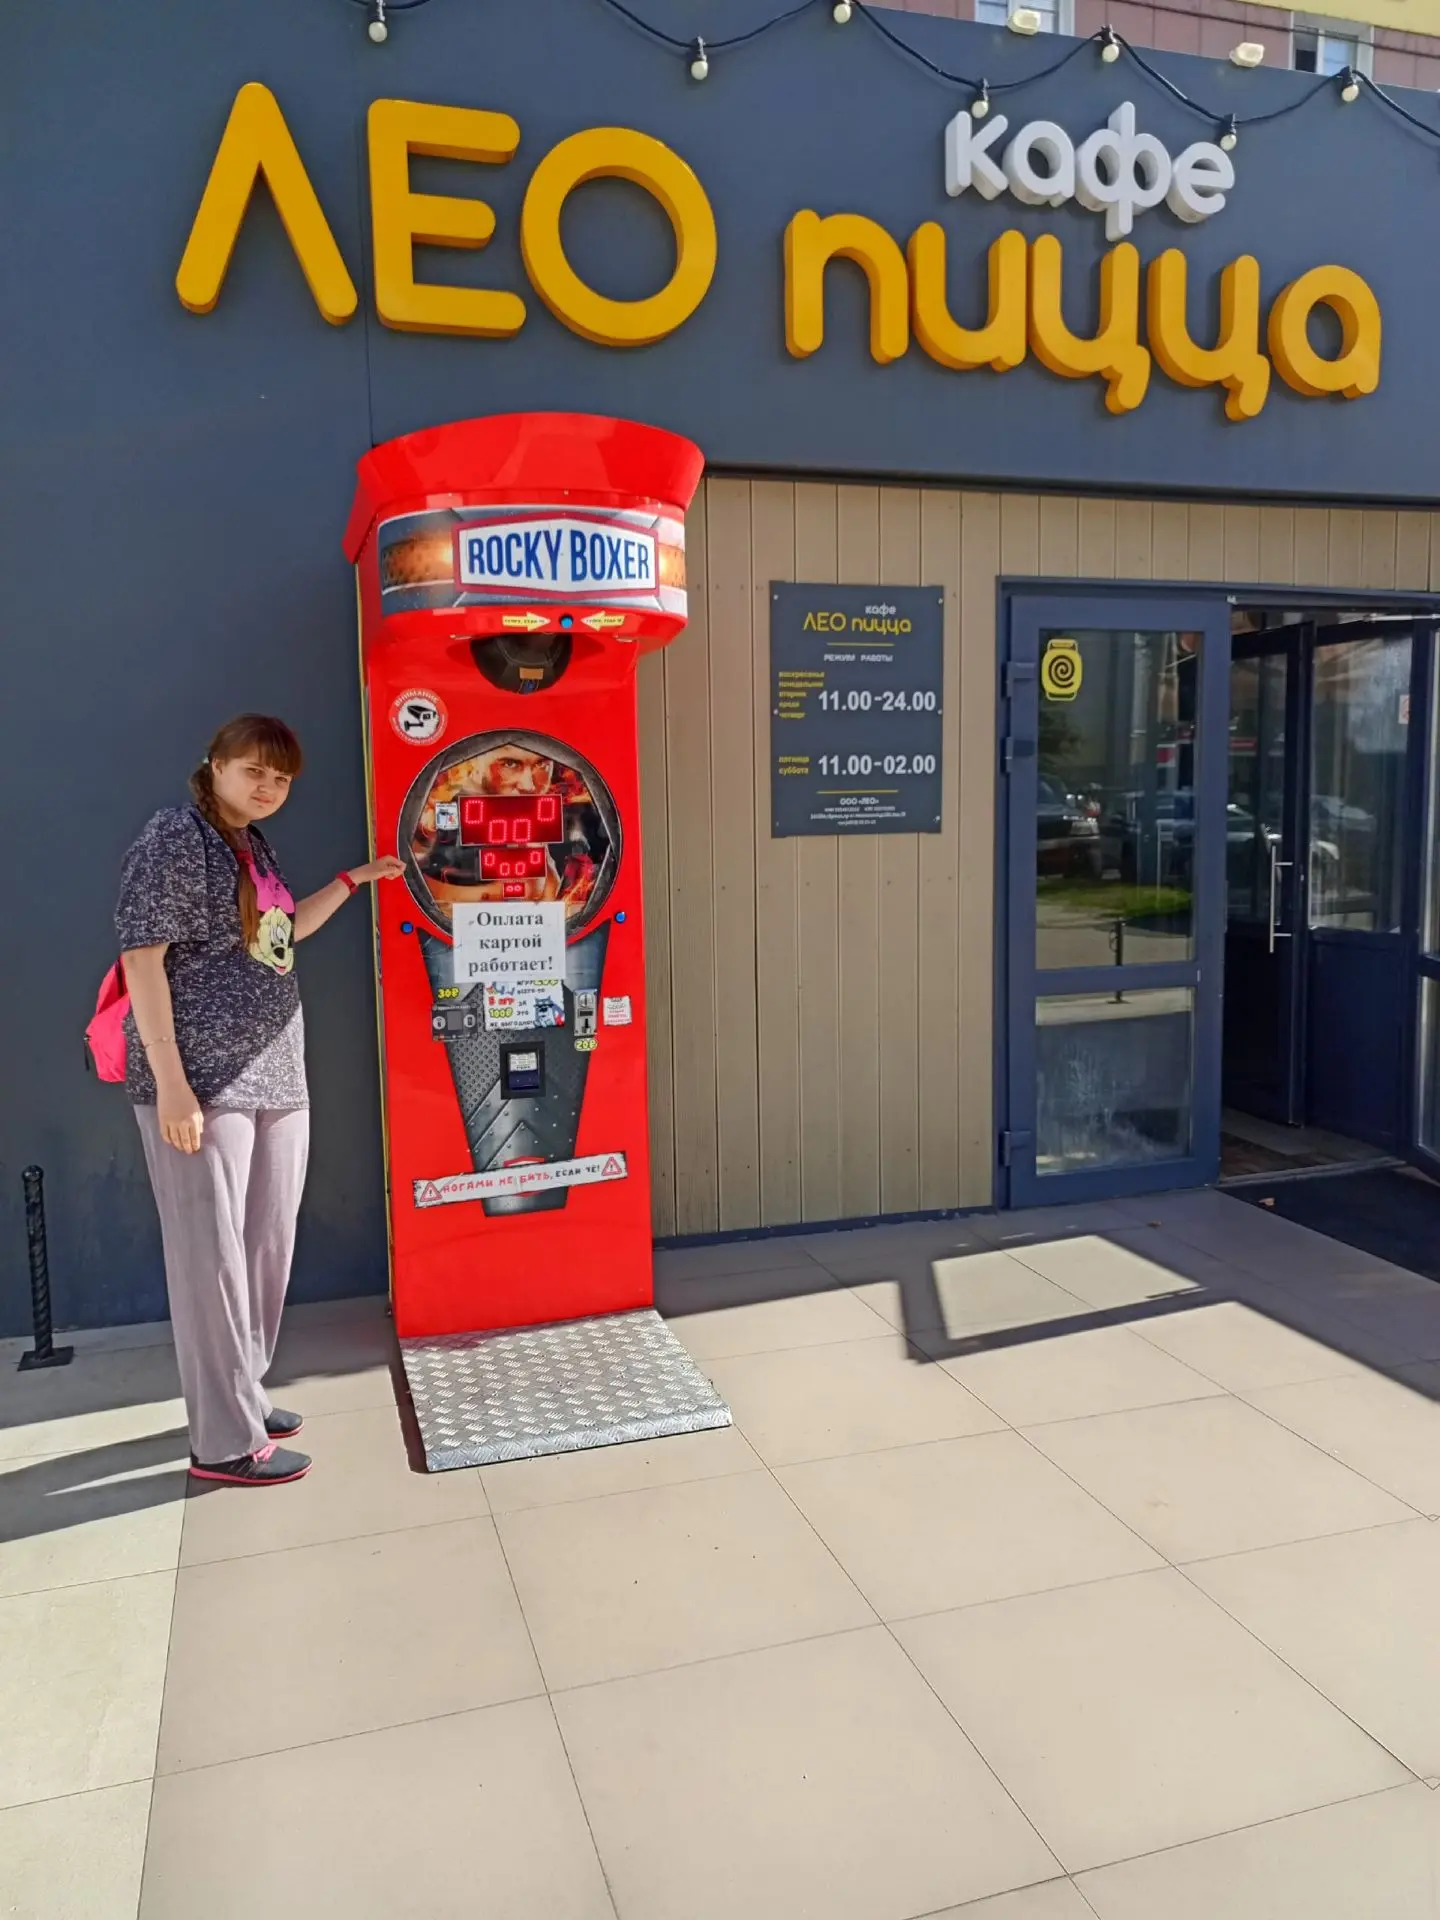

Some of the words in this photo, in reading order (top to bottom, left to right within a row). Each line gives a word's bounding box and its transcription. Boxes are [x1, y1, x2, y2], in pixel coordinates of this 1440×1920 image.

[945, 101, 1235, 241] кафе
[176, 81, 717, 347] ЛЕО
[784, 209, 1382, 421] пицца
[468, 529, 562, 581] ROCKY
[569, 529, 649, 582] BOXER
[865, 602, 896, 617] кафе
[803, 611, 847, 632] ЛЕО
[851, 616, 912, 636] пицца
[823, 653, 856, 662] РЕЖИМ
[860, 653, 893, 663] РАБОТЫ
[477, 912, 544, 926] Оплата
[480, 934, 542, 953] картой
[468, 956, 553, 977] работает!
[443, 1181, 493, 1194] НОГАМИ
[499, 1176, 513, 1185] НЕ
[555, 1168, 581, 1178] ЕСЛИ
